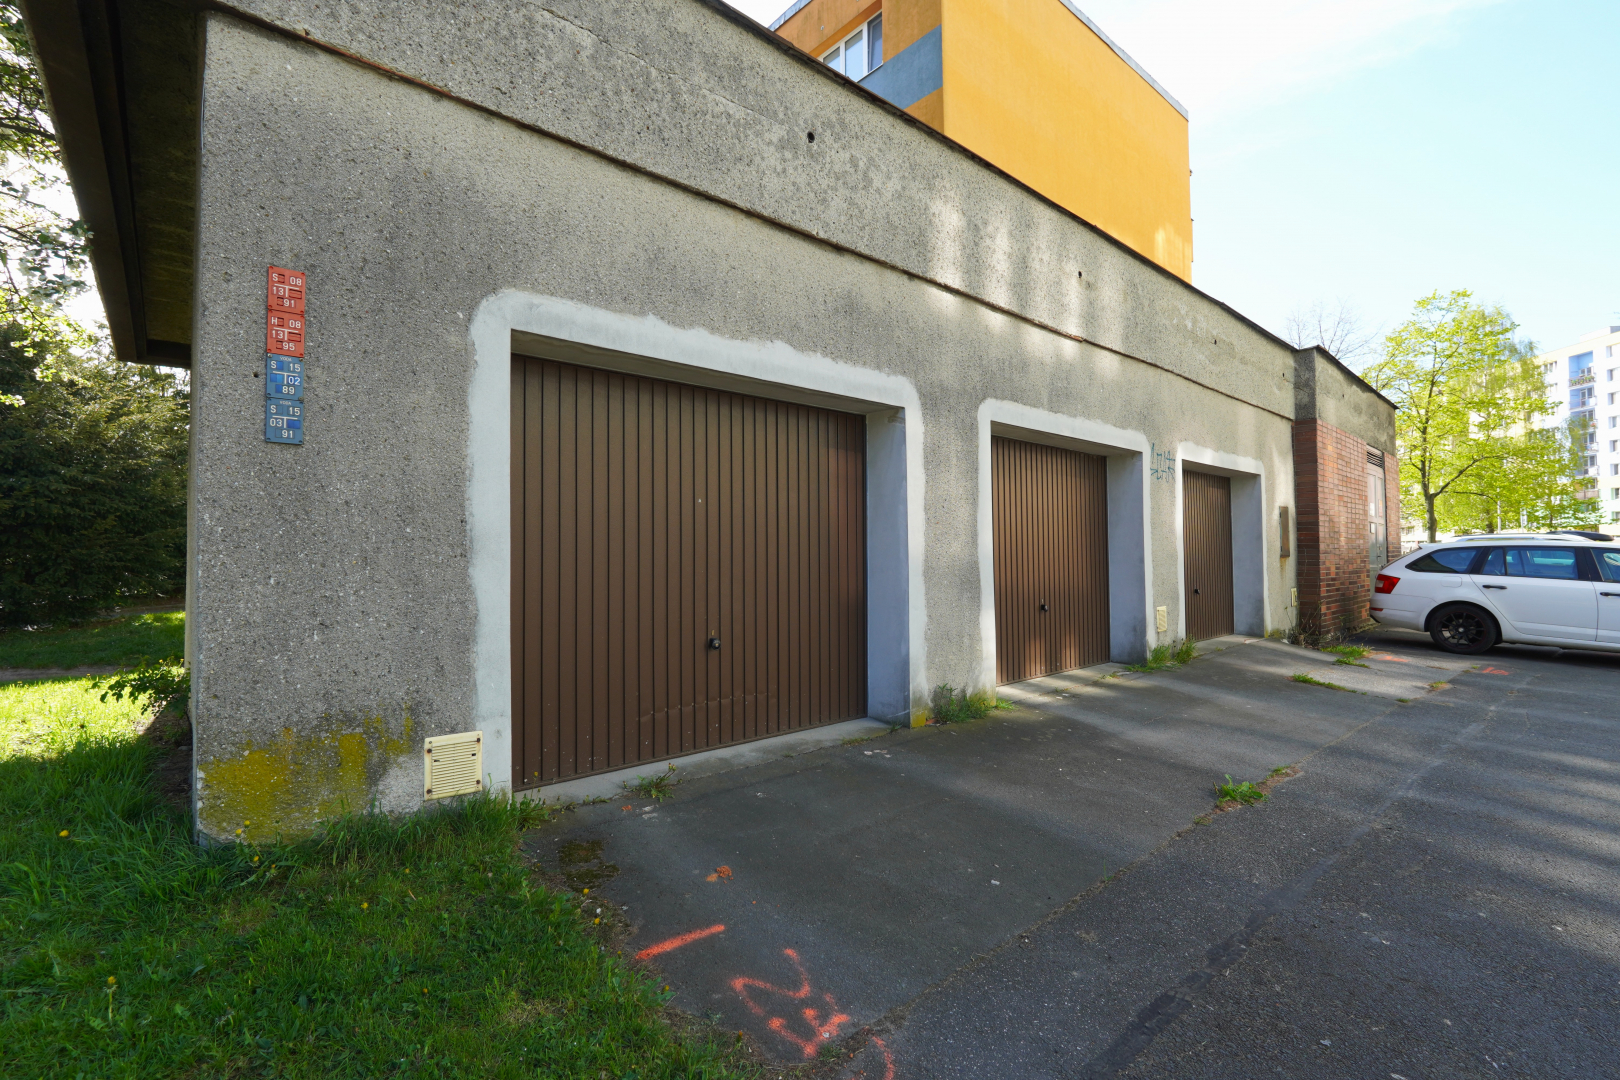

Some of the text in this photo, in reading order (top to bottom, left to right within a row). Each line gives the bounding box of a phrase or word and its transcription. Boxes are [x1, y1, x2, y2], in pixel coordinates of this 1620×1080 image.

[272, 273, 302, 286] S 08
[272, 286, 284, 296] 13
[283, 298, 295, 308] 91
[271, 316, 301, 329] H 08
[272, 330, 283, 339] 13
[282, 341, 295, 351] 95
[270, 360, 301, 372] S 15
[288, 376, 301, 385] 02
[282, 385, 295, 395] 89
[270, 405, 301, 416] S 15
[269, 418, 282, 427] 03
[282, 429, 293, 438] 91
